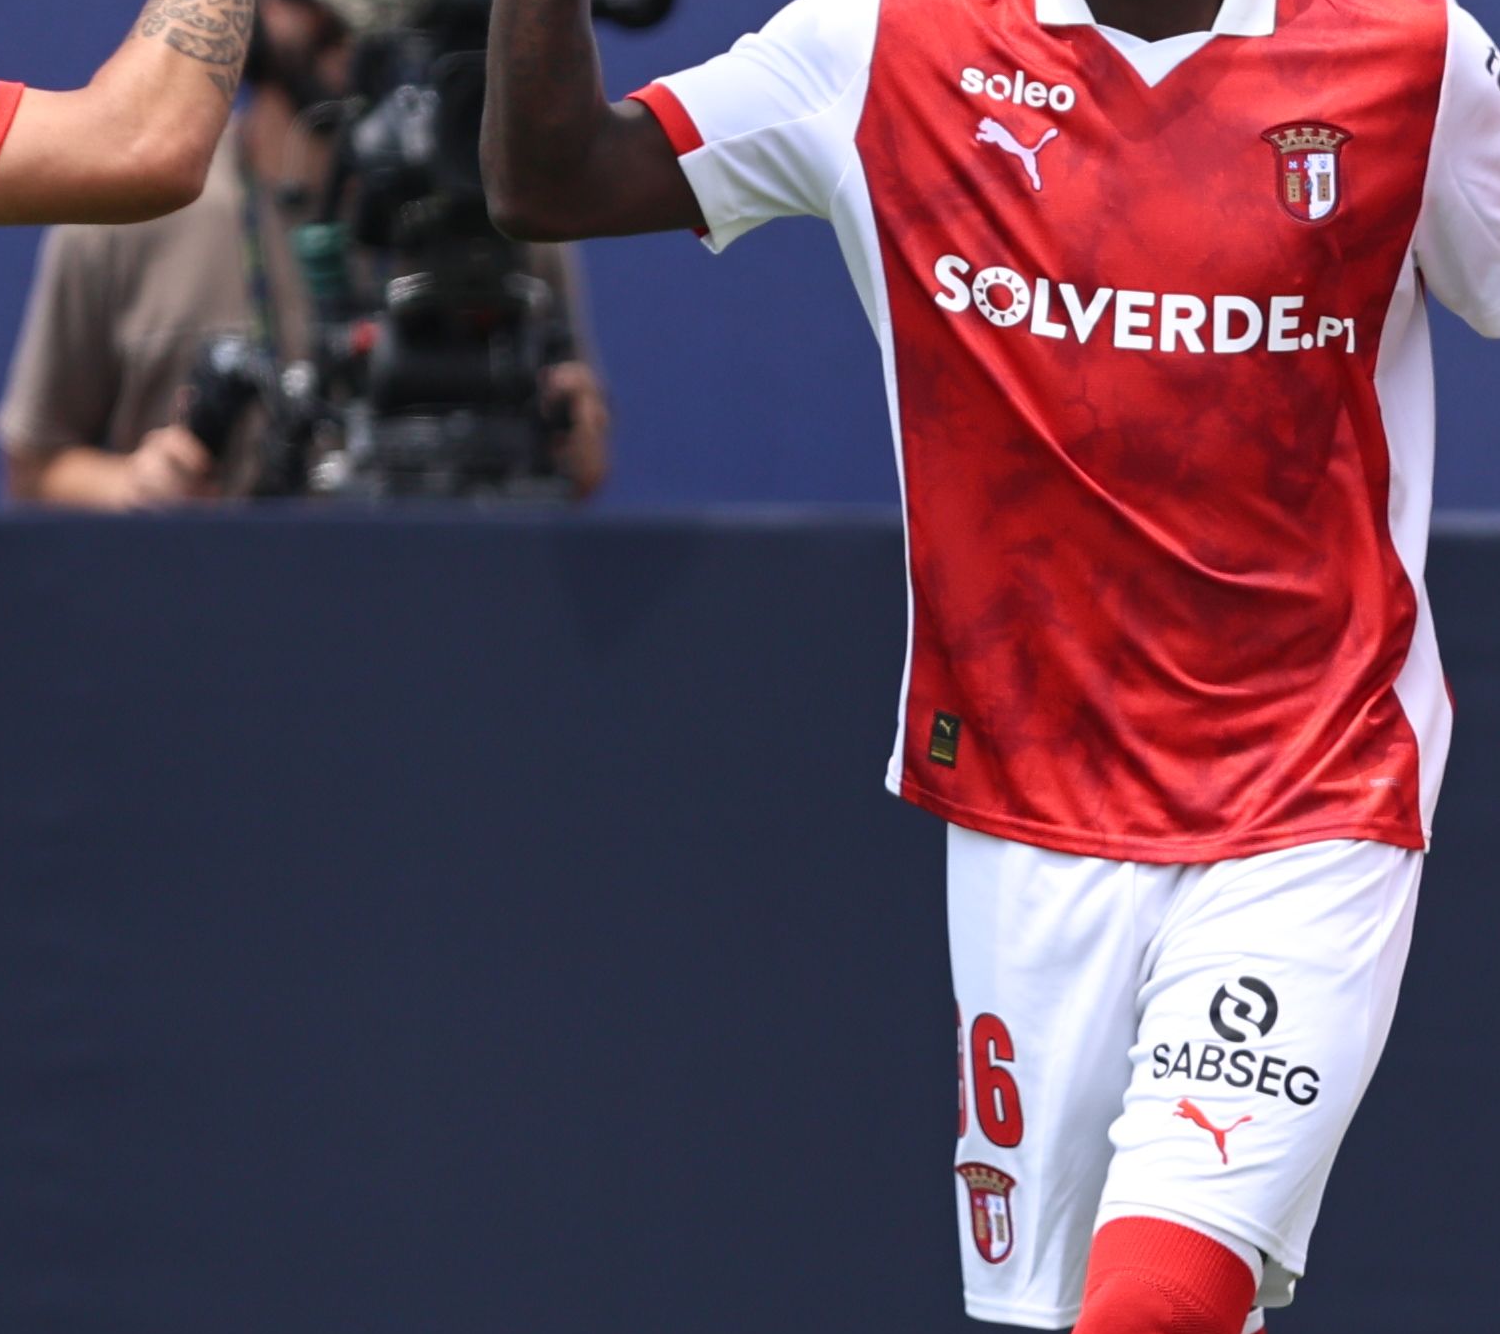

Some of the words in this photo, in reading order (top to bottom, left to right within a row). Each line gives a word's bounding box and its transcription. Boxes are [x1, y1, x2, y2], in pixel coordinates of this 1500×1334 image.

[960, 66, 1077, 113] soleo
[933, 253, 1356, 355] SOLVERDE.PT
[1152, 1041, 1321, 1106] SABSEG
